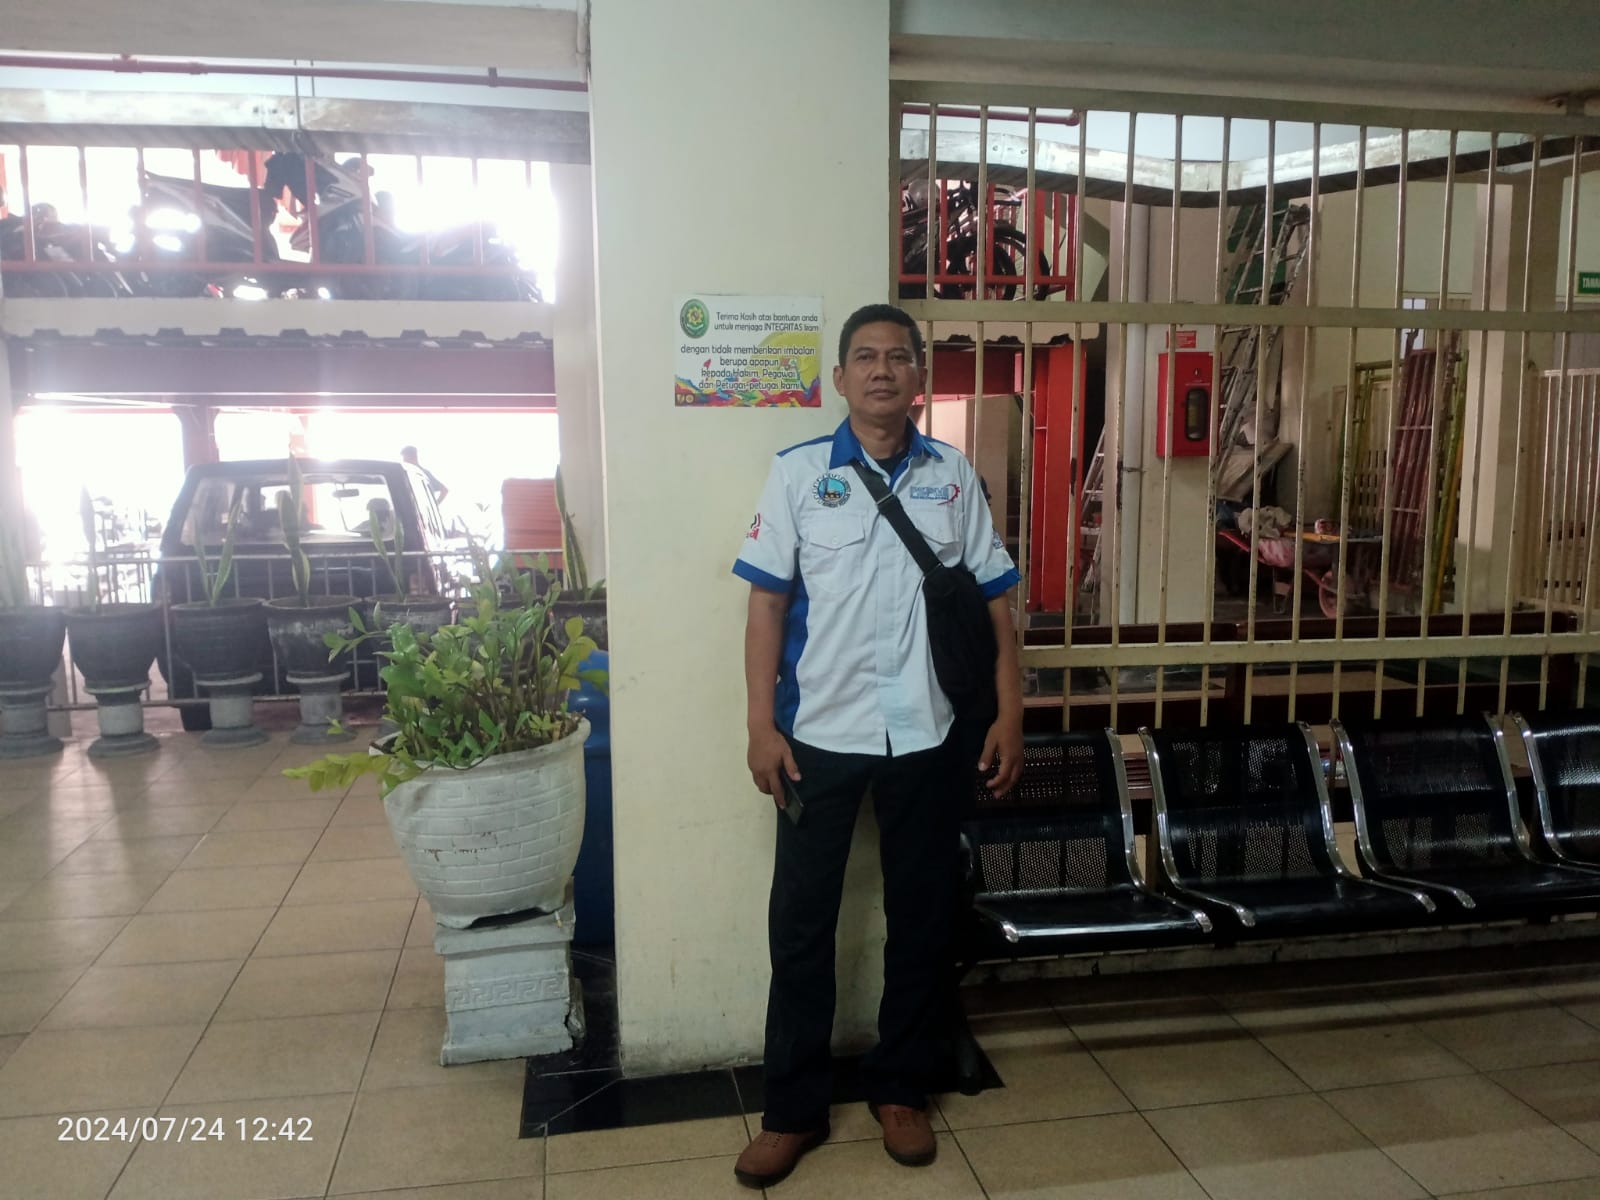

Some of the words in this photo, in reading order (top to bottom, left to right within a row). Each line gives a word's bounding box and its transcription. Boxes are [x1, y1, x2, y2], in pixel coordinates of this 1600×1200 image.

[716, 311, 739, 321] Terima
[773, 312, 800, 322] bantuan
[802, 313, 818, 322] anda
[714, 321, 733, 330] untuk
[735, 323, 763, 332] menjaga
[764, 322, 803, 331] INTEGRITAS
[680, 344, 709, 355] dengan
[711, 345, 733, 354] tidak
[734, 345, 782, 354] memberikan
[783, 345, 815, 355] imbalan
[719, 357, 747, 367] berupa
[749, 358, 778, 367] apapun
[701, 368, 731, 378] kepada
[762, 369, 796, 379] Pegawai
[698, 381, 714, 390] dan
[780, 381, 800, 390] kami
